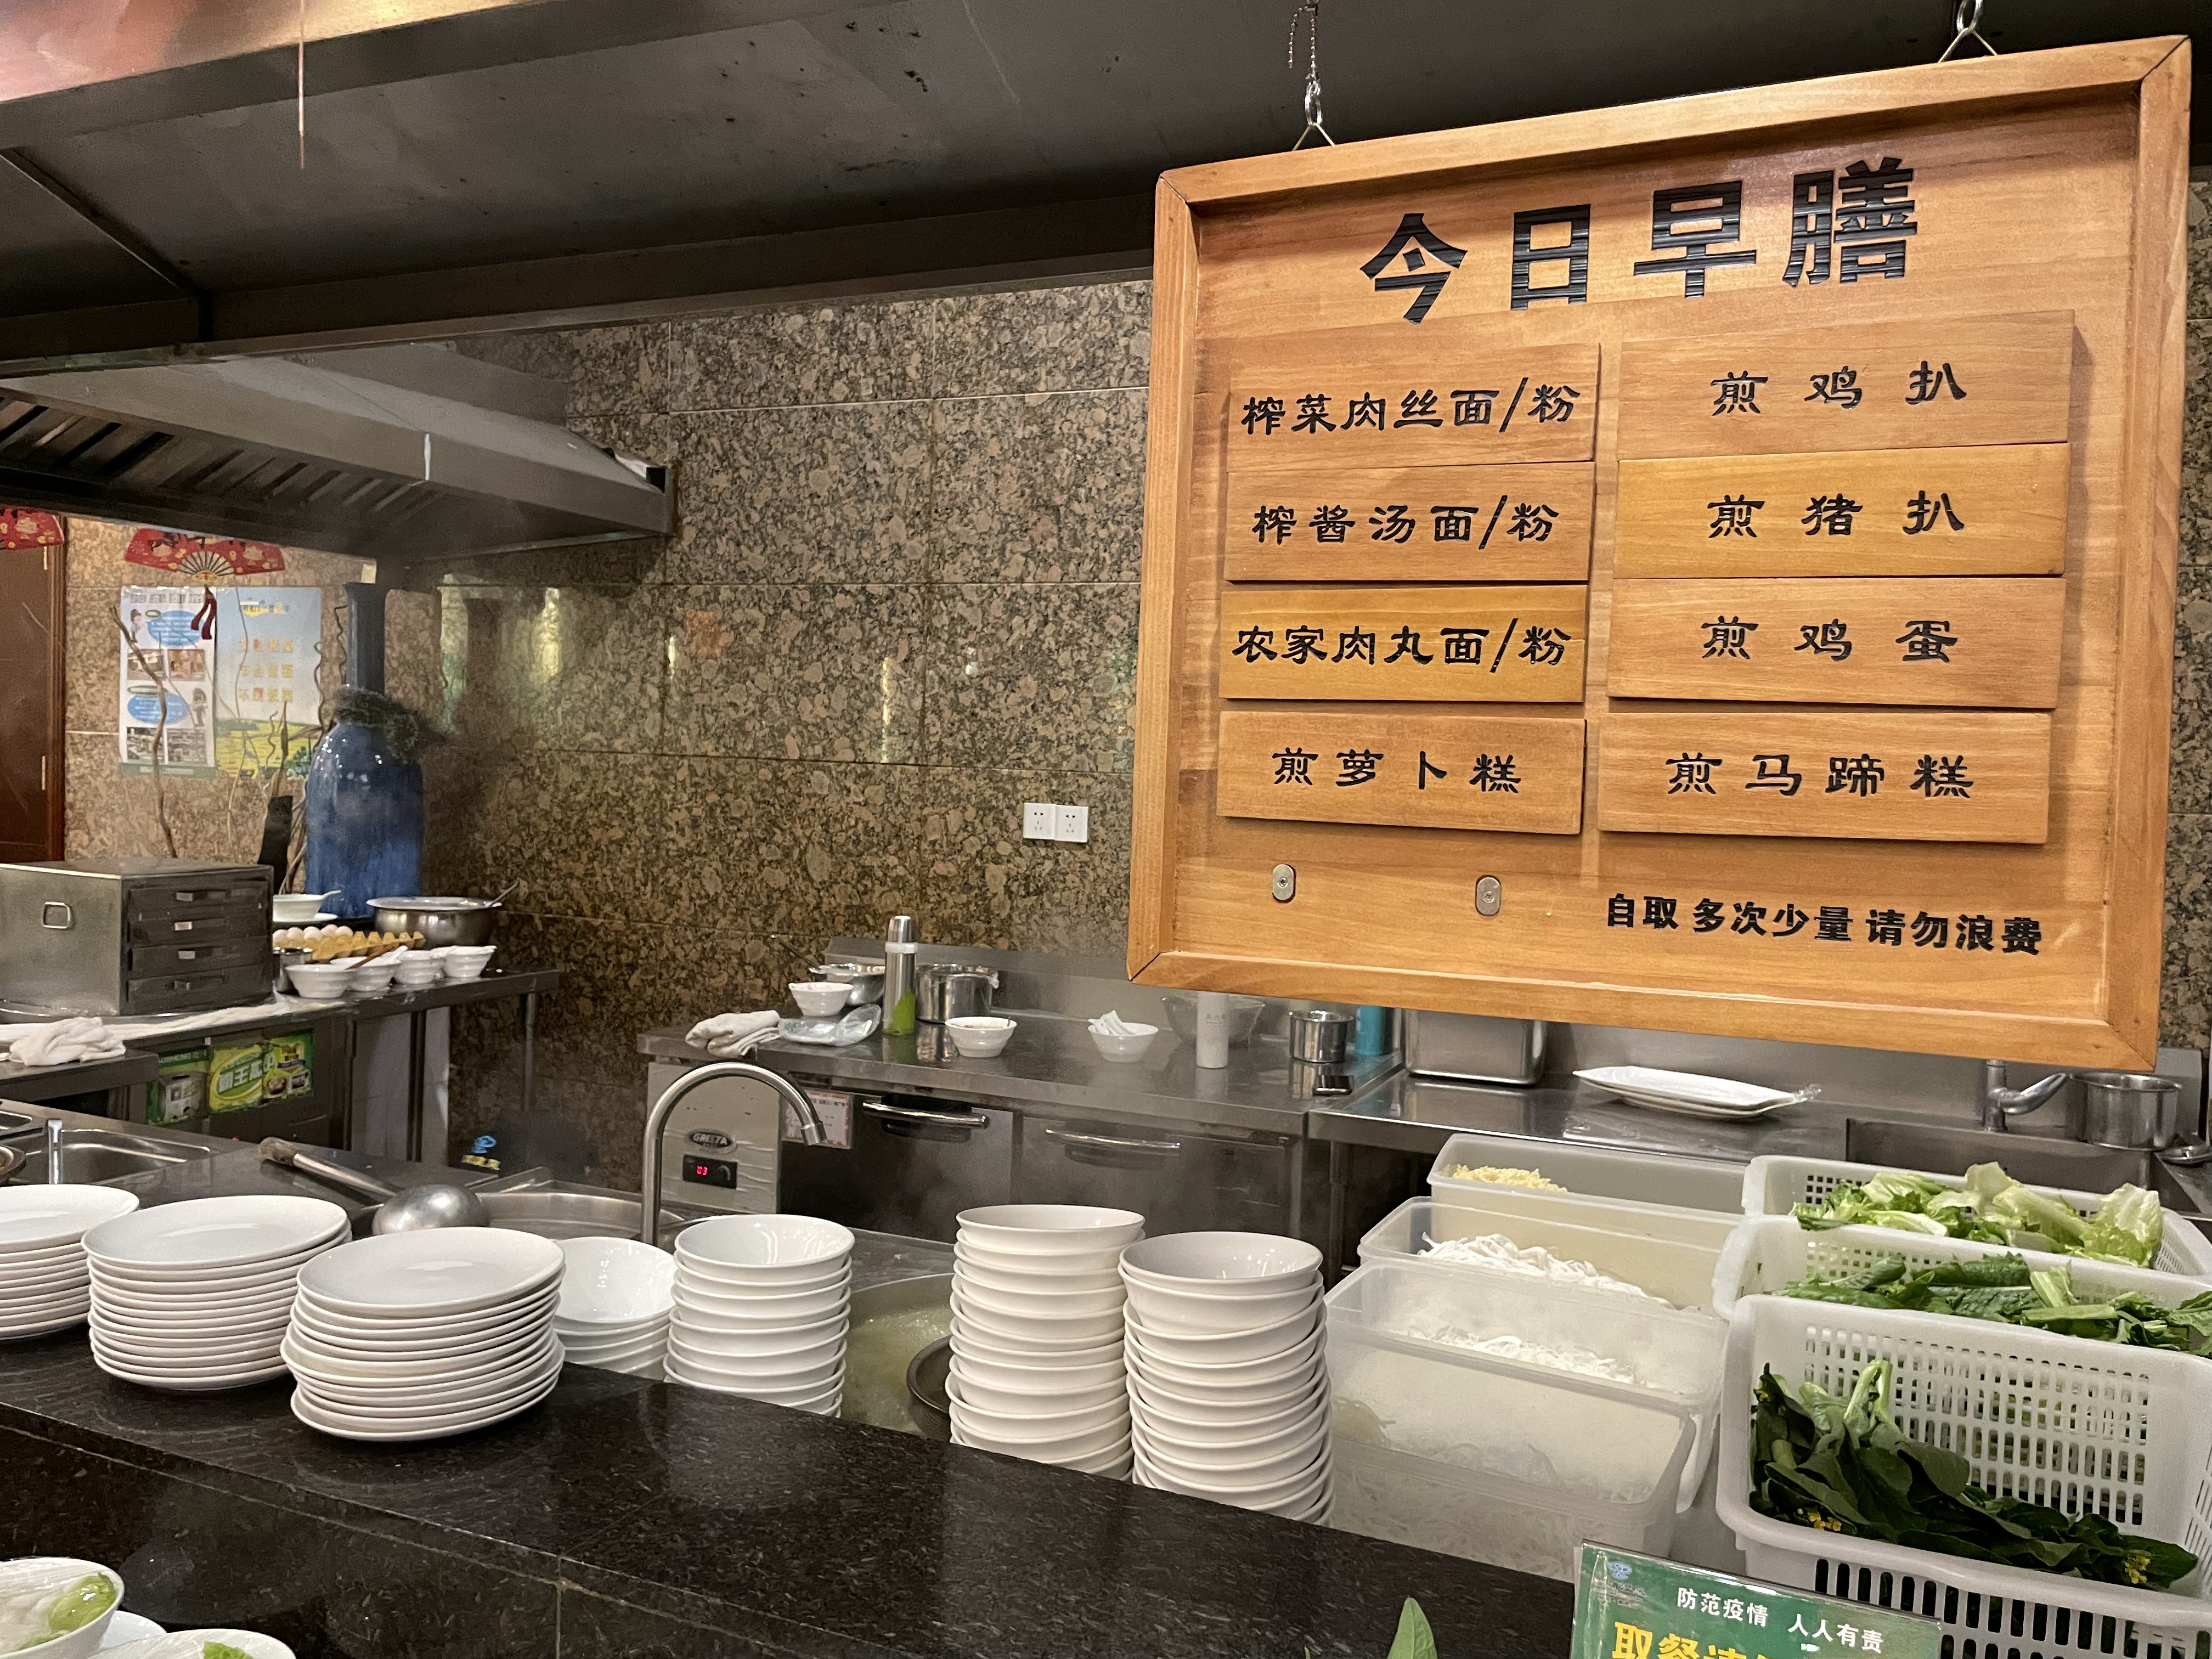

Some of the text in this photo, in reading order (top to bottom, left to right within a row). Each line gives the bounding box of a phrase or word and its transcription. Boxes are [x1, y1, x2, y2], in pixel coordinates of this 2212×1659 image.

[1359, 156, 1918, 325] 今日早膳
[1242, 377, 1580, 435] 榨菜肉丝面/粉
[1711, 361, 1966, 416] 煎鸡扒
[1252, 495, 1559, 549] 榨酱汤面/粉
[1708, 490, 1964, 538] 煎猪扒
[1232, 618, 1571, 673] 农家肉丸面/粉
[1701, 616, 1957, 662] 煎鸡蛋
[1272, 747, 1521, 793] 煎萝卜糕
[1666, 753, 1973, 798] 煎马蹄糕
[1608, 893, 2041, 955] 自取 多次少量 请勿浪费
[1677, 1587, 1769, 1627] 防范疫情
[1788, 1614, 1883, 1654] 人人有责
